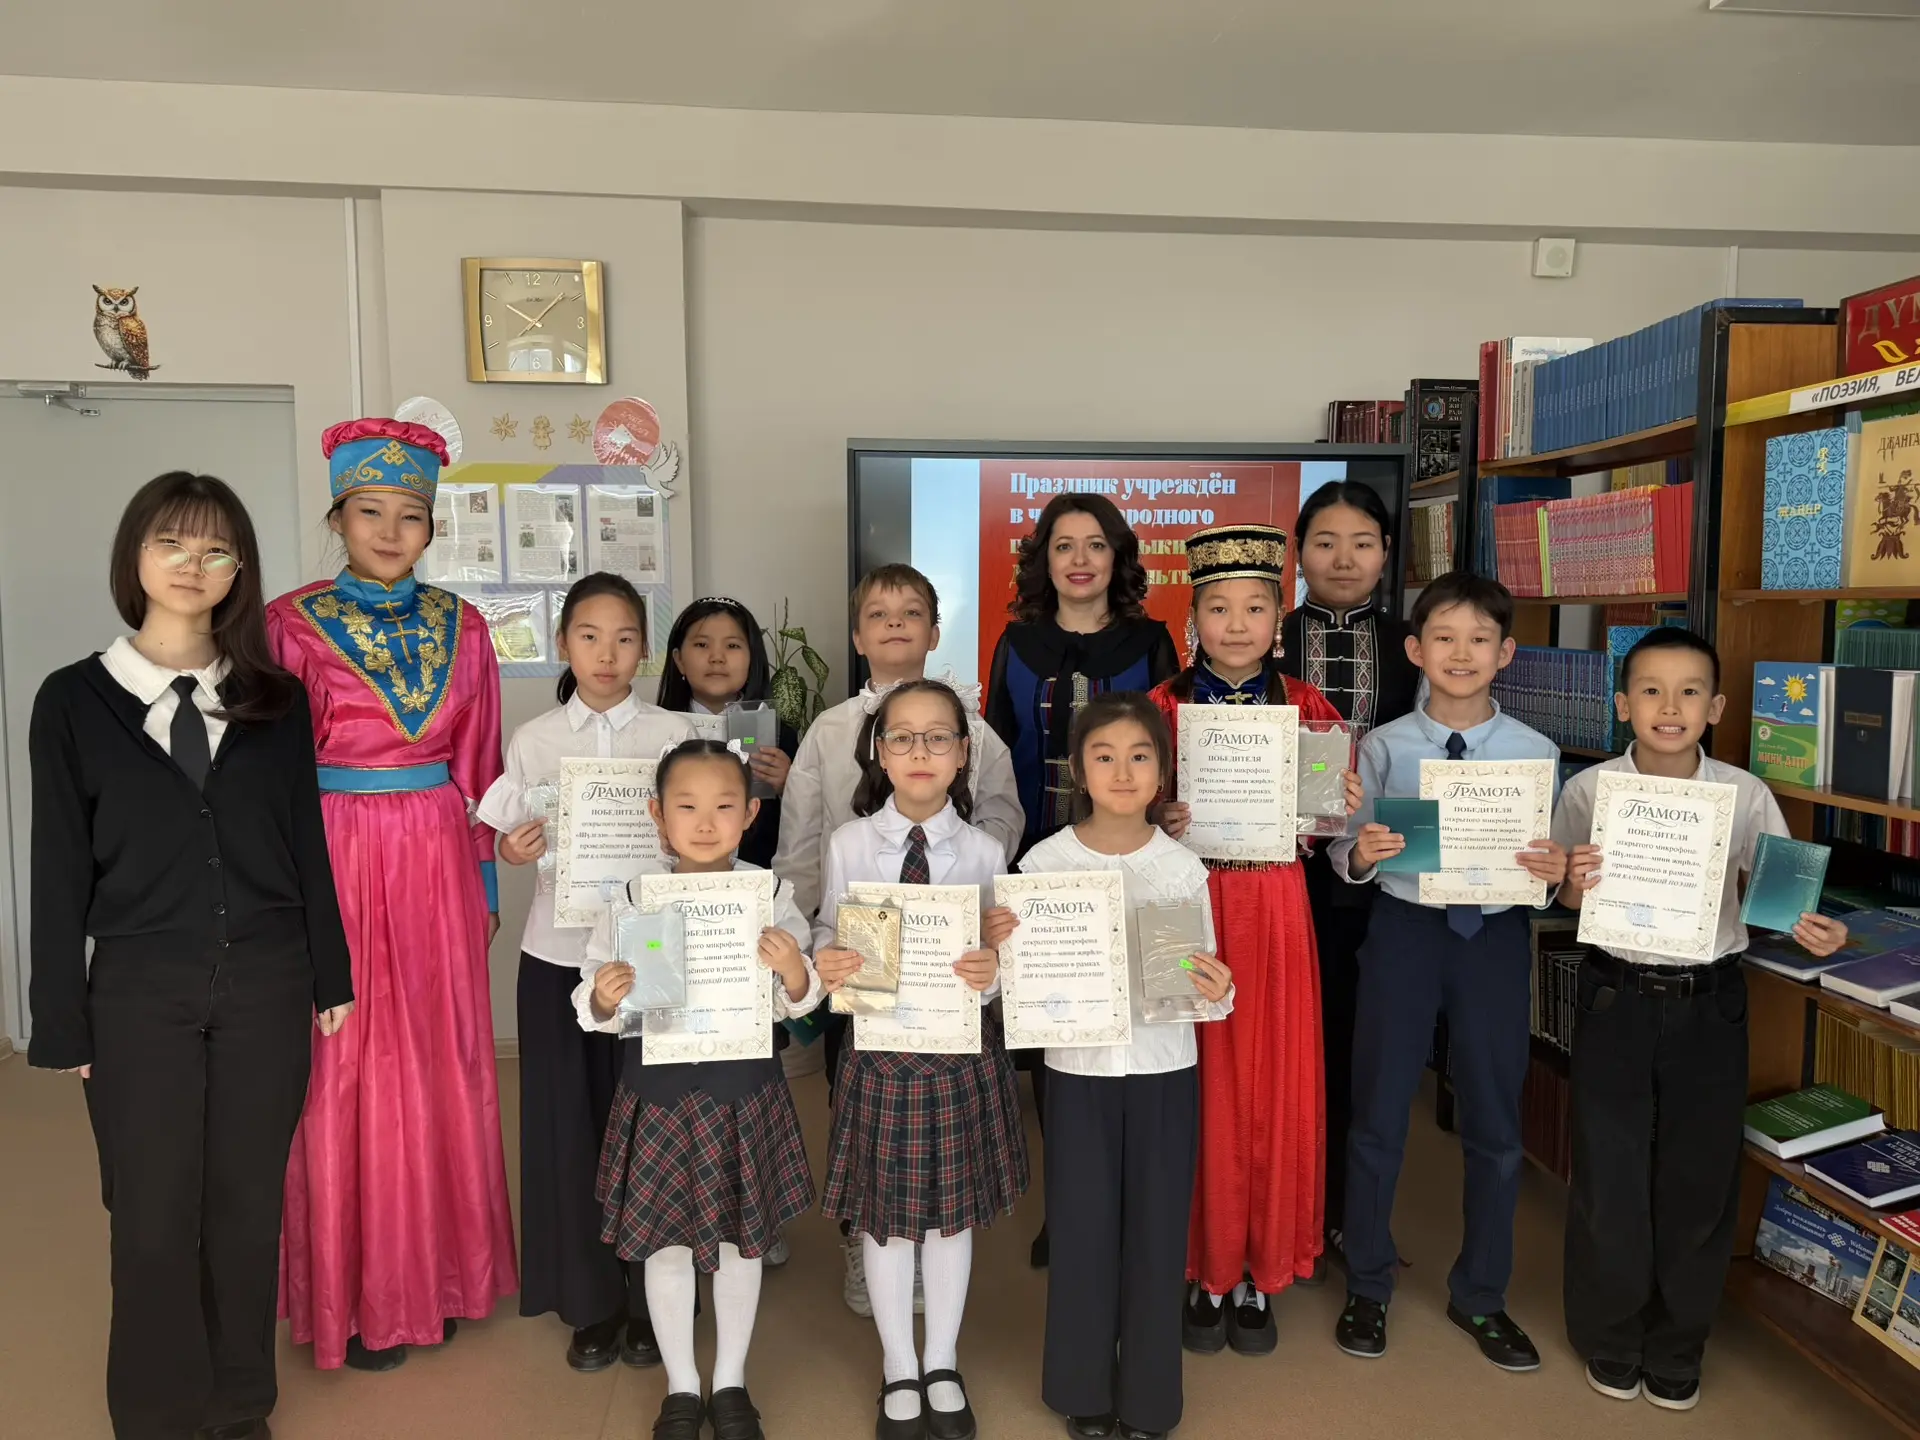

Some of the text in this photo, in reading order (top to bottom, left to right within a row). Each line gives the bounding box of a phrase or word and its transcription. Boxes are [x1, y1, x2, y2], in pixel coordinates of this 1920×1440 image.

[526, 272, 541, 286] 12
[484, 315, 493, 327] 9
[577, 316, 585, 329] 3
[532, 358, 541, 370] 6
[1811, 375, 1881, 402] «ПОЭЗИЯ,
[1010, 472, 1236, 500] Праздник учреждён
[1010, 508, 1024, 523] в
[1119, 508, 1215, 528] родного
[617, 820, 653, 828] микрофона
[1627, 827, 1689, 841] ПОБЕДИТЕЛЯ
[1655, 845, 1697, 855] микрофона
[1668, 869, 1695, 877] рамках
[1031, 925, 1088, 934] ПОБЕДИТЕЛЯ
[902, 936, 941, 944] ЕДИТЕЛЯ
[1059, 938, 1098, 946] микрофона
[705, 941, 745, 950] микрофона
[912, 949, 951, 957] микрофона
[722, 966, 747, 974] рамках
